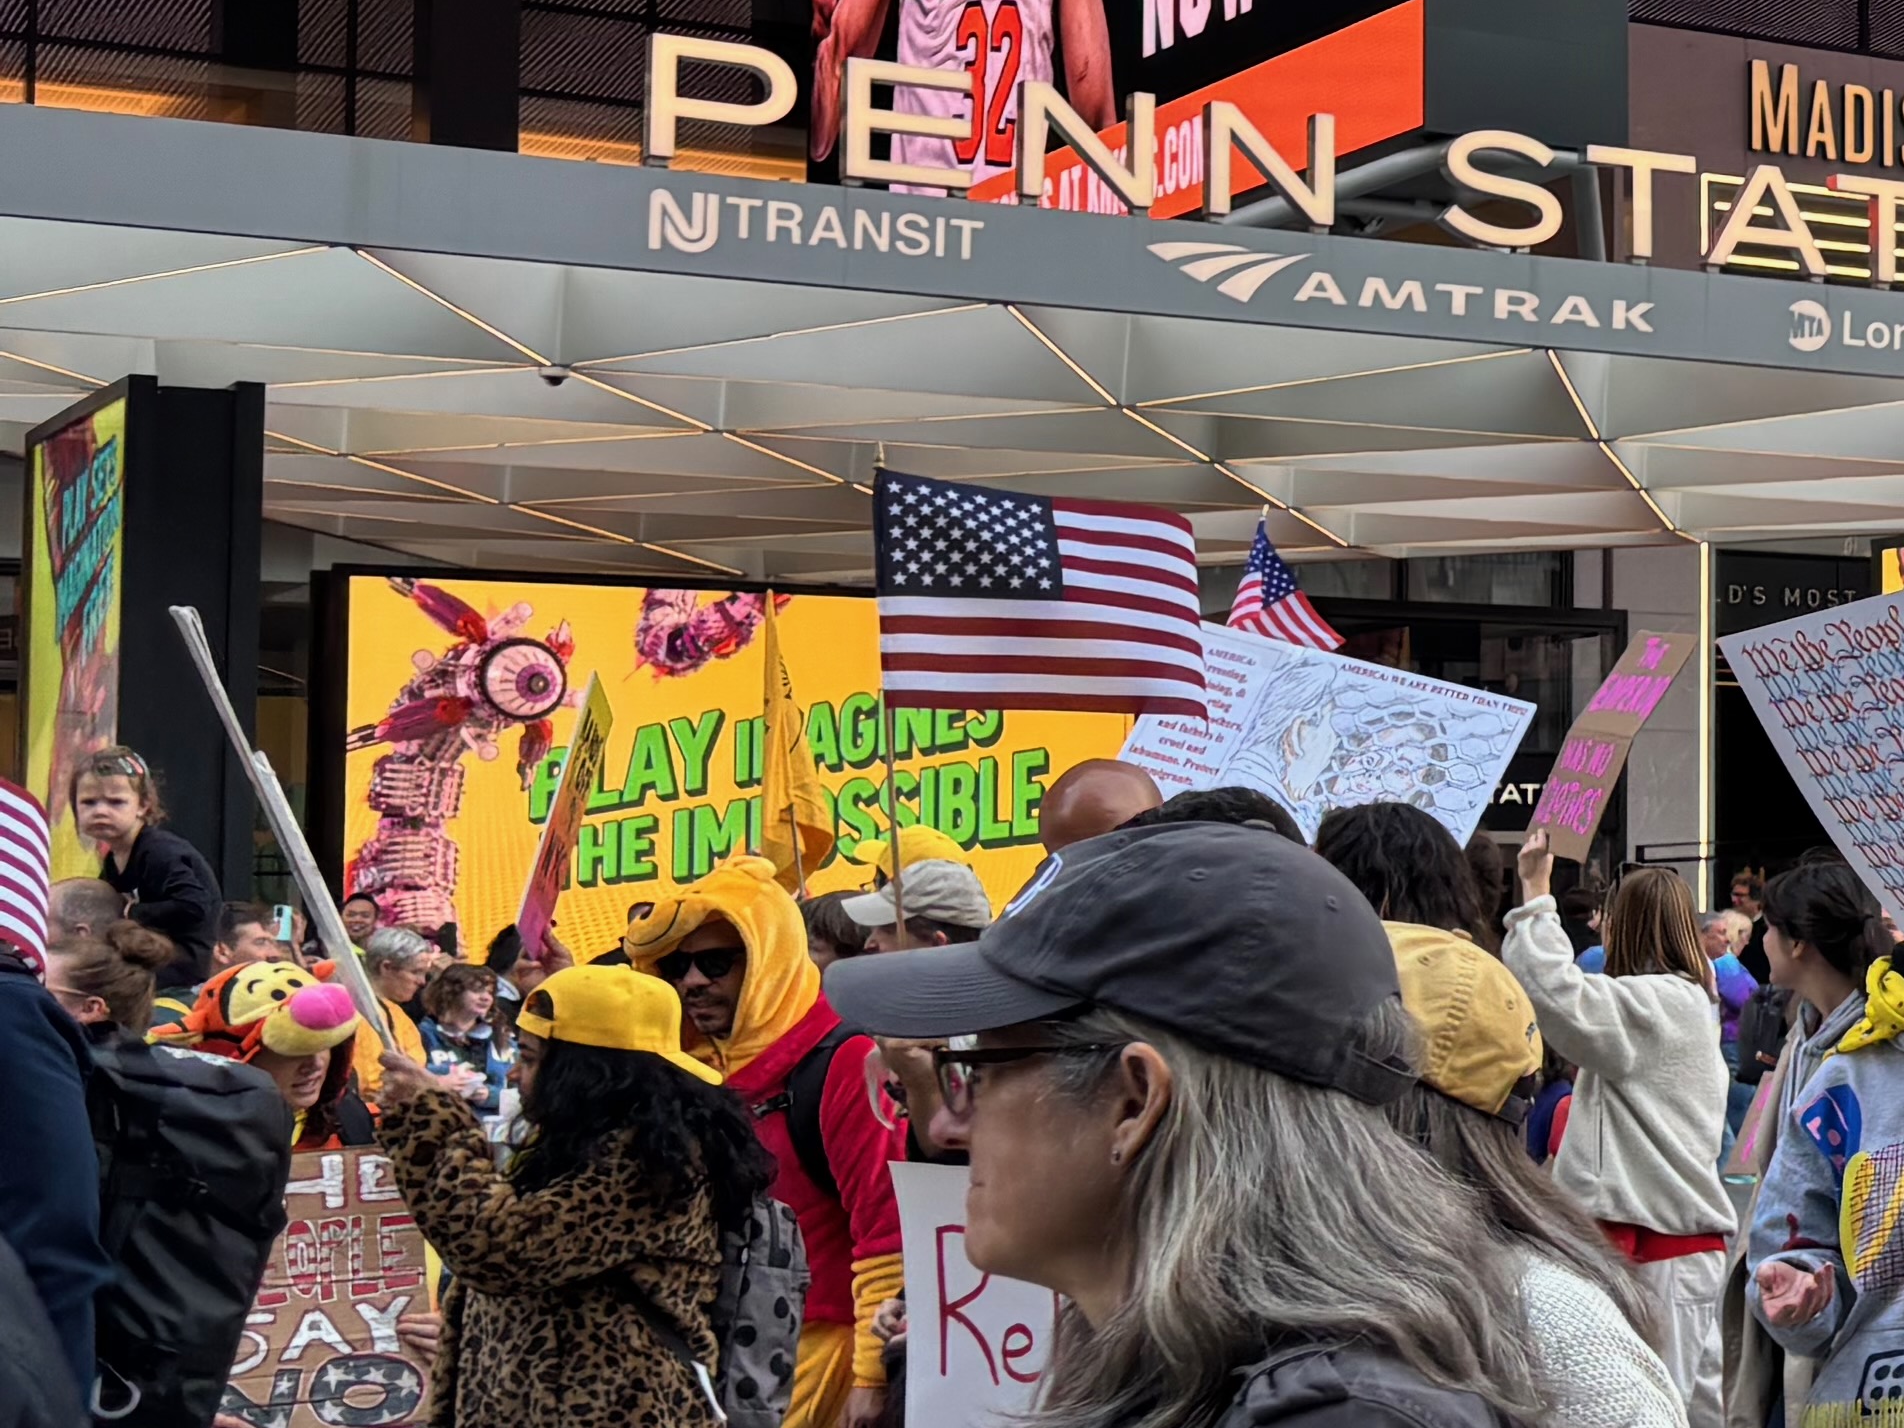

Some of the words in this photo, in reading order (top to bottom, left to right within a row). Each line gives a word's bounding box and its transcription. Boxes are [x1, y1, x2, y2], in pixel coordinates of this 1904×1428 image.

[645, 34, 1334, 229] PENN
[952, 1, 1023, 167] 32
[723, 194, 985, 262] TRANSIT
[1294, 269, 1656, 334] AMTRAK
[735, 690, 1003, 786] IAGINES
